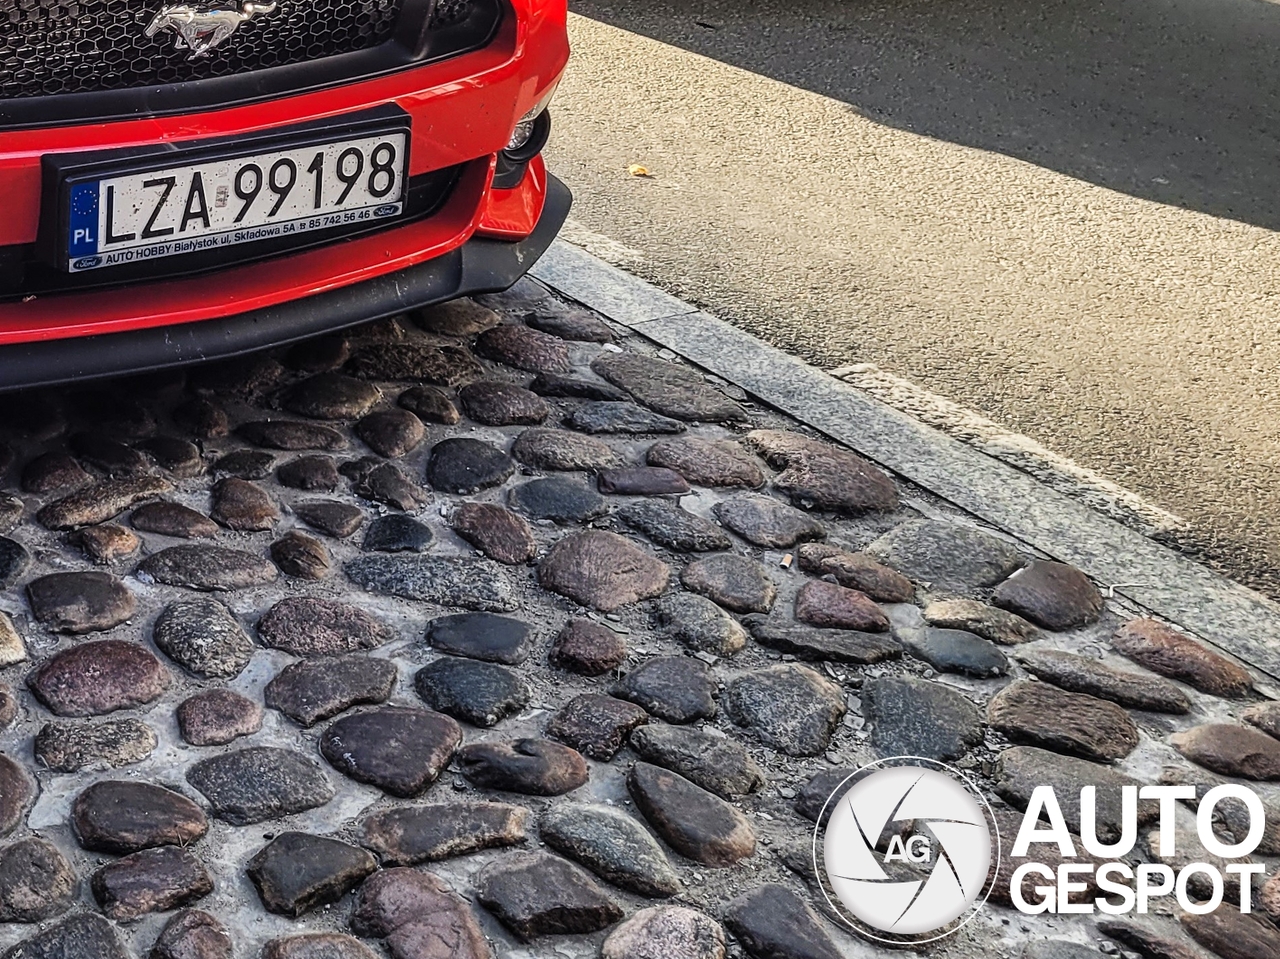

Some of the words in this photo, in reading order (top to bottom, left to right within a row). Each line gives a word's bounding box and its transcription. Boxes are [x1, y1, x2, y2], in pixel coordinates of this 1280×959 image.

[105, 171, 211, 246] LZA
[233, 142, 396, 223] 99198
[74, 228, 94, 245] PL
[75, 256, 100, 268] Ford
[105, 251, 134, 264] AUTO
[136, 244, 172, 259] HOBBY
[174, 236, 218, 252] Białystok
[234, 227, 280, 242] Składowa
[283, 223, 296, 233] 5A
[308, 219, 321, 229] 85
[323, 215, 341, 226] 742
[343, 212, 355, 222] 56
[358, 210, 370, 220] 46
